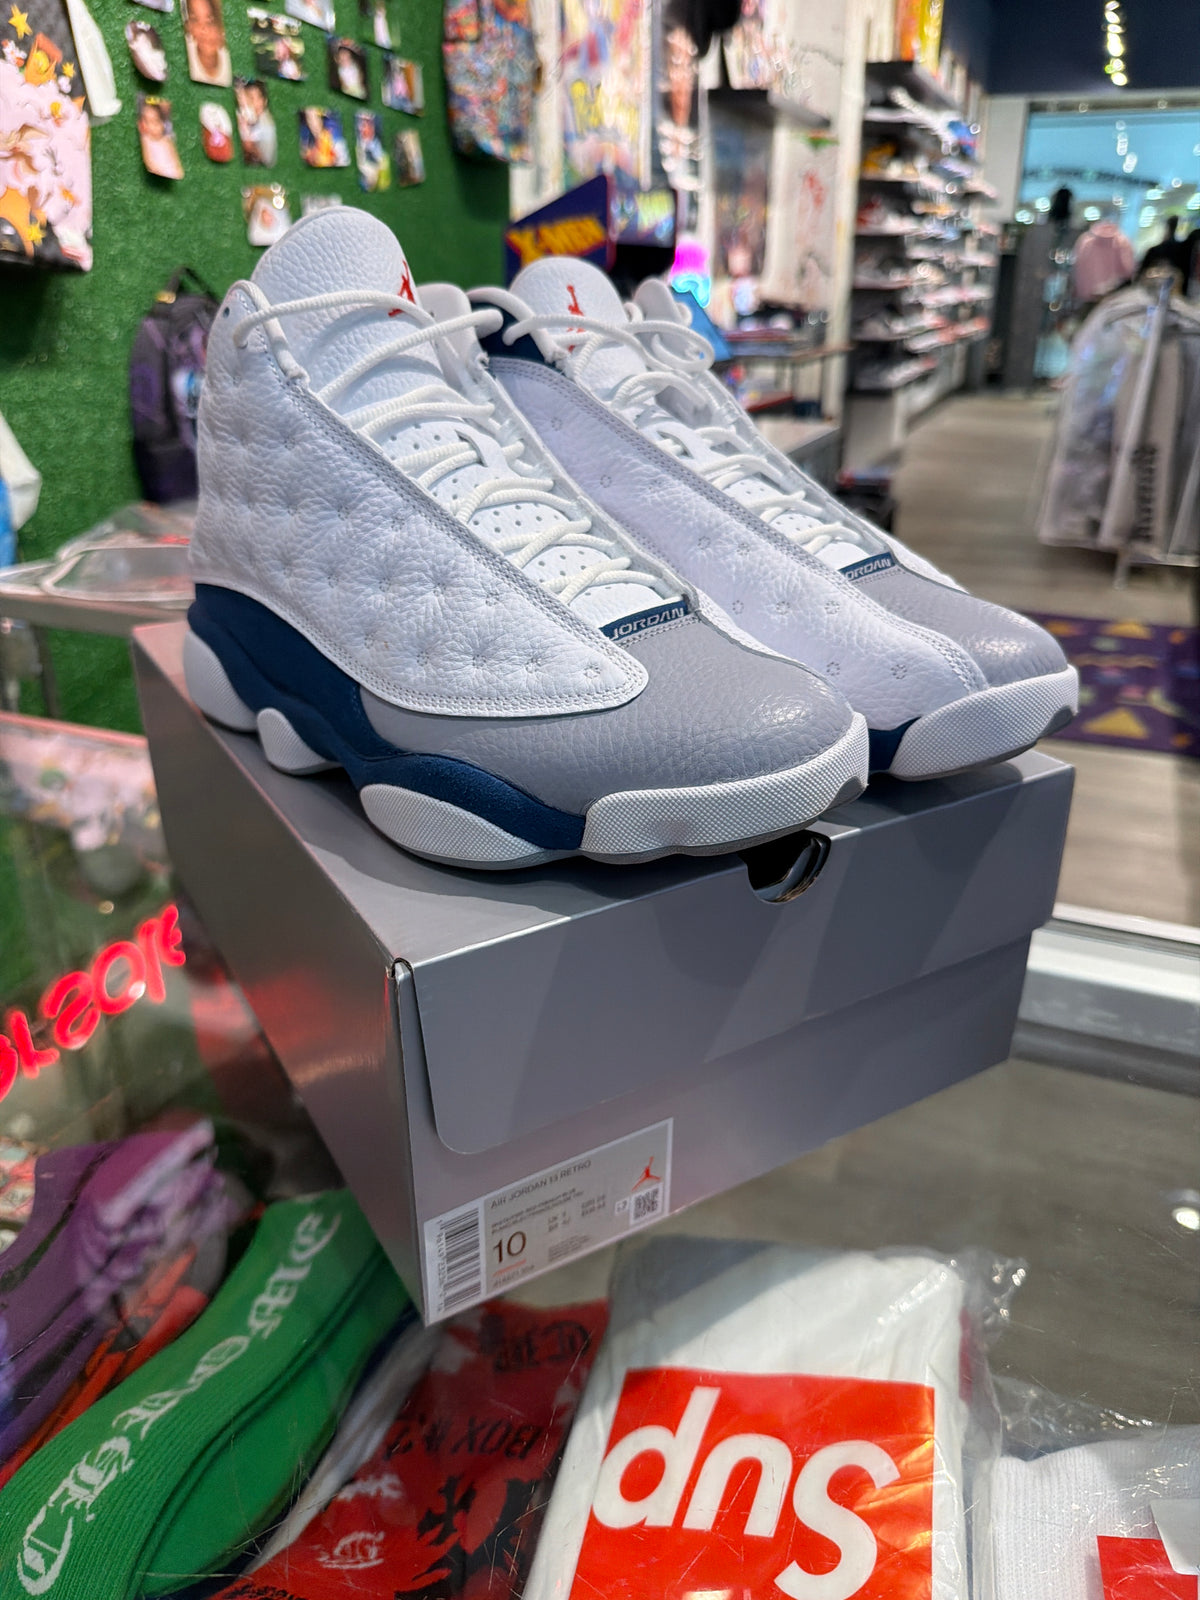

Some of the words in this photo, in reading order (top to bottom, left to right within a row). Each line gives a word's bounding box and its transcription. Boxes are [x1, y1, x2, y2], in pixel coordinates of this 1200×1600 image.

[844, 557, 892, 580] ORDAN
[609, 607, 684, 641] JORDAN
[490, 1197, 507, 1210] AIR
[509, 1178, 547, 1201] JORDAN
[560, 1159, 592, 1179] RETRO
[493, 1231, 526, 1263] 10
[449, 1414, 544, 1461] BOX
